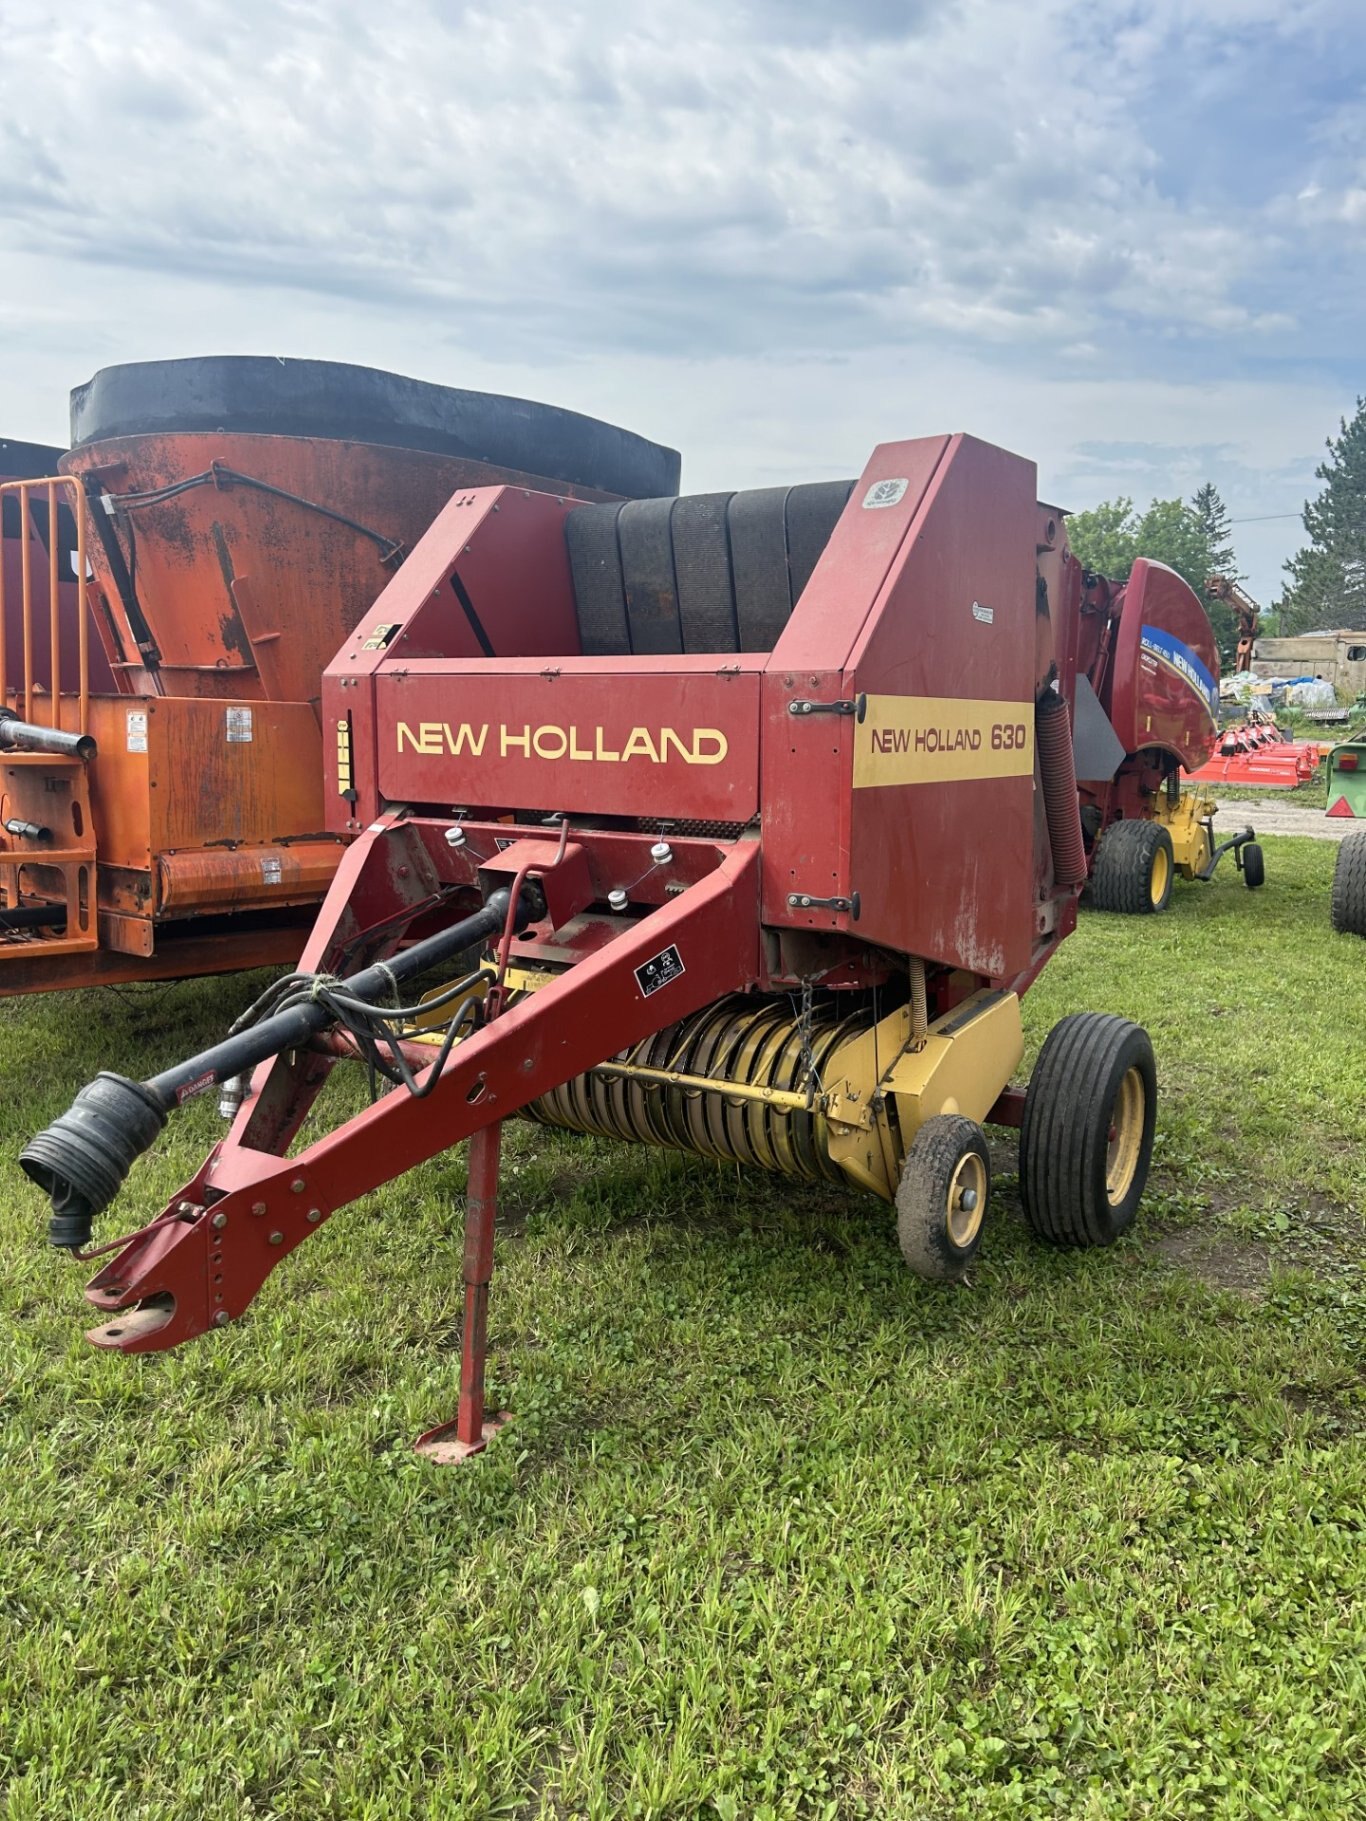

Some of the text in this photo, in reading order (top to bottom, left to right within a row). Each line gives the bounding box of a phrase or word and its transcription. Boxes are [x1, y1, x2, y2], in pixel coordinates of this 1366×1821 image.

[1173, 651, 1211, 703] NEW HOLLAND
[397, 722, 728, 765] NEW HOLLAND
[871, 724, 1026, 754] NEW HOLLAND 630
